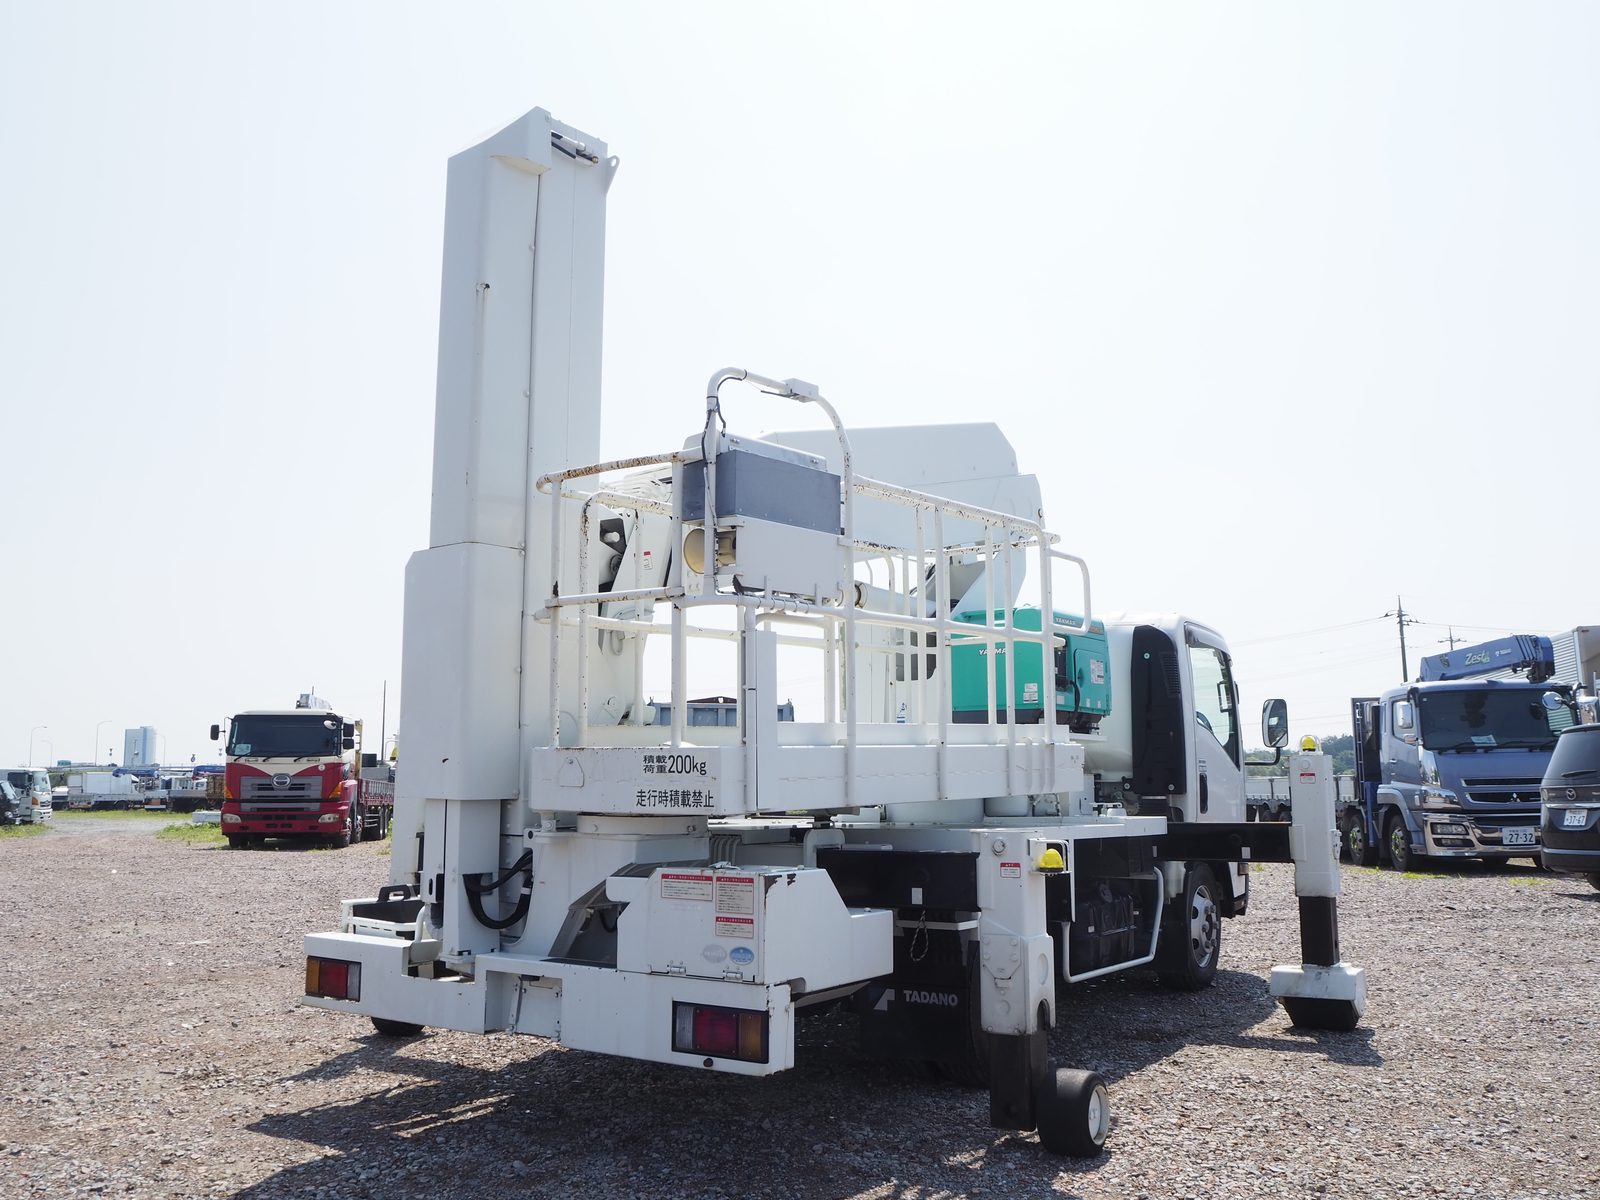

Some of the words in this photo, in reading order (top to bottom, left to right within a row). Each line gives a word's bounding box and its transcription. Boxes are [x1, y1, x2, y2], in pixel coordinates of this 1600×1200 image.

[643, 755, 667, 764] 積載
[668, 755, 707, 776] 200kg
[643, 764, 667, 774] 荷重
[636, 789, 714, 808] 走行時積載禁止
[1508, 833, 1534, 843] 27-32
[904, 990, 958, 1006] TADANO
